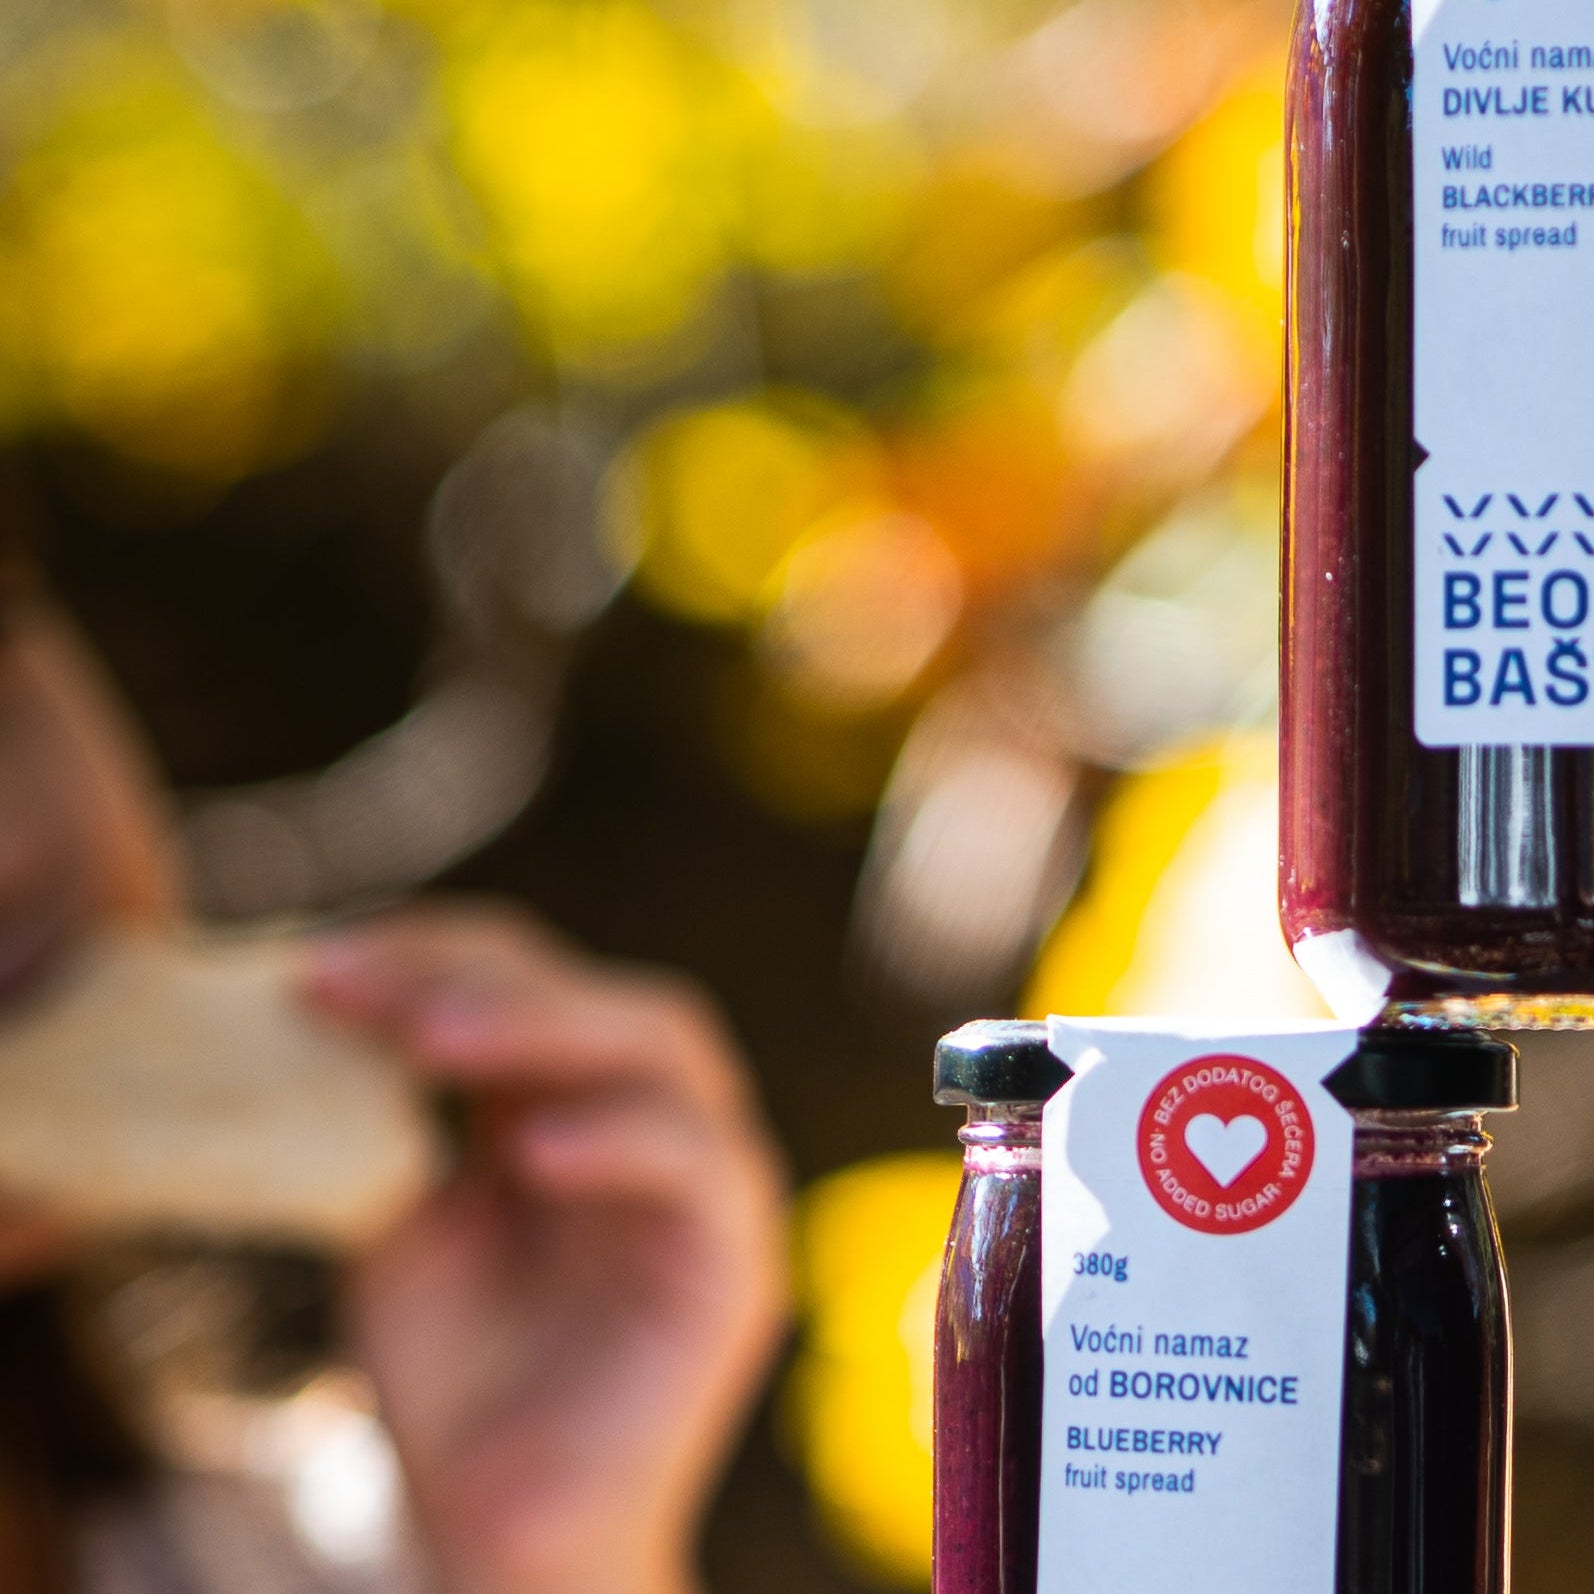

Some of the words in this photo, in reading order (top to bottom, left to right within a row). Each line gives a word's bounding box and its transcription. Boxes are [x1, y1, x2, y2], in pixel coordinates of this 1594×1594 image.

[1443, 40, 1518, 71] Voćni
[1443, 86, 1548, 117] DIVLJE
[1442, 146, 1492, 170] Wild
[1441, 223, 1486, 248] fruit
[1495, 222, 1577, 251] spread
[1444, 569, 1589, 630] BEO
[1154, 1086, 1184, 1125] BEZ
[1183, 1067, 1279, 1102] DODATOG
[1150, 1133, 1167, 1163] NO
[1156, 1168, 1210, 1217] ADDED
[1215, 1183, 1281, 1220] SUGAR
[1075, 1252, 1128, 1283] 380g
[1071, 1324, 1142, 1354] Voćni
[1155, 1334, 1248, 1359] namaz
[1069, 1369, 1098, 1397] od
[1110, 1370, 1298, 1405] BOROVNICE
[1067, 1426, 1221, 1455] BLUEBERRY
[1065, 1463, 1107, 1489] fruit
[1115, 1469, 1194, 1495] spread
